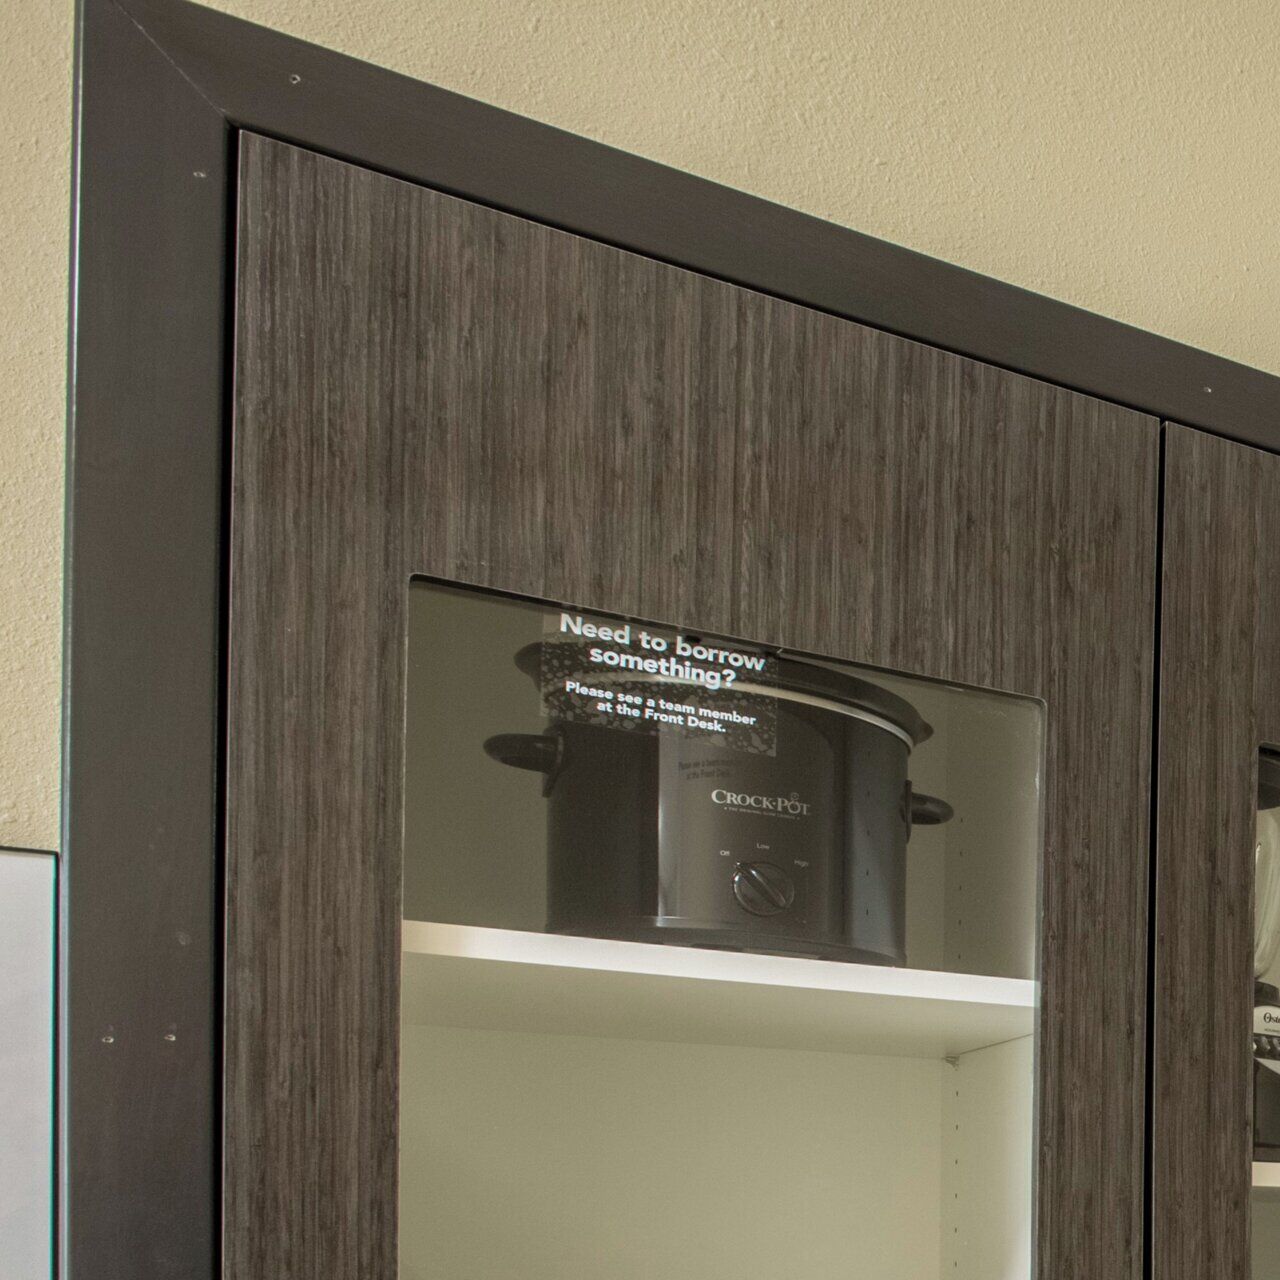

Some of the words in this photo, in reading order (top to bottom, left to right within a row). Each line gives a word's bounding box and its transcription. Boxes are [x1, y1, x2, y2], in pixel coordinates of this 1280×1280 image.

[560, 612, 631, 645] Need
[639, 631, 668, 652] to
[676, 635, 766, 671] borrow
[590, 648, 736, 690] something?
[565, 680, 614, 700] Please
[617, 691, 643, 705] see
[647, 697, 656, 708] a
[658, 698, 696, 715] team
[699, 707, 757, 726] member
[597, 701, 613, 713] at
[615, 703, 641, 718] the
[645, 708, 685, 726] Front
[687, 715, 726, 733] Desk.
